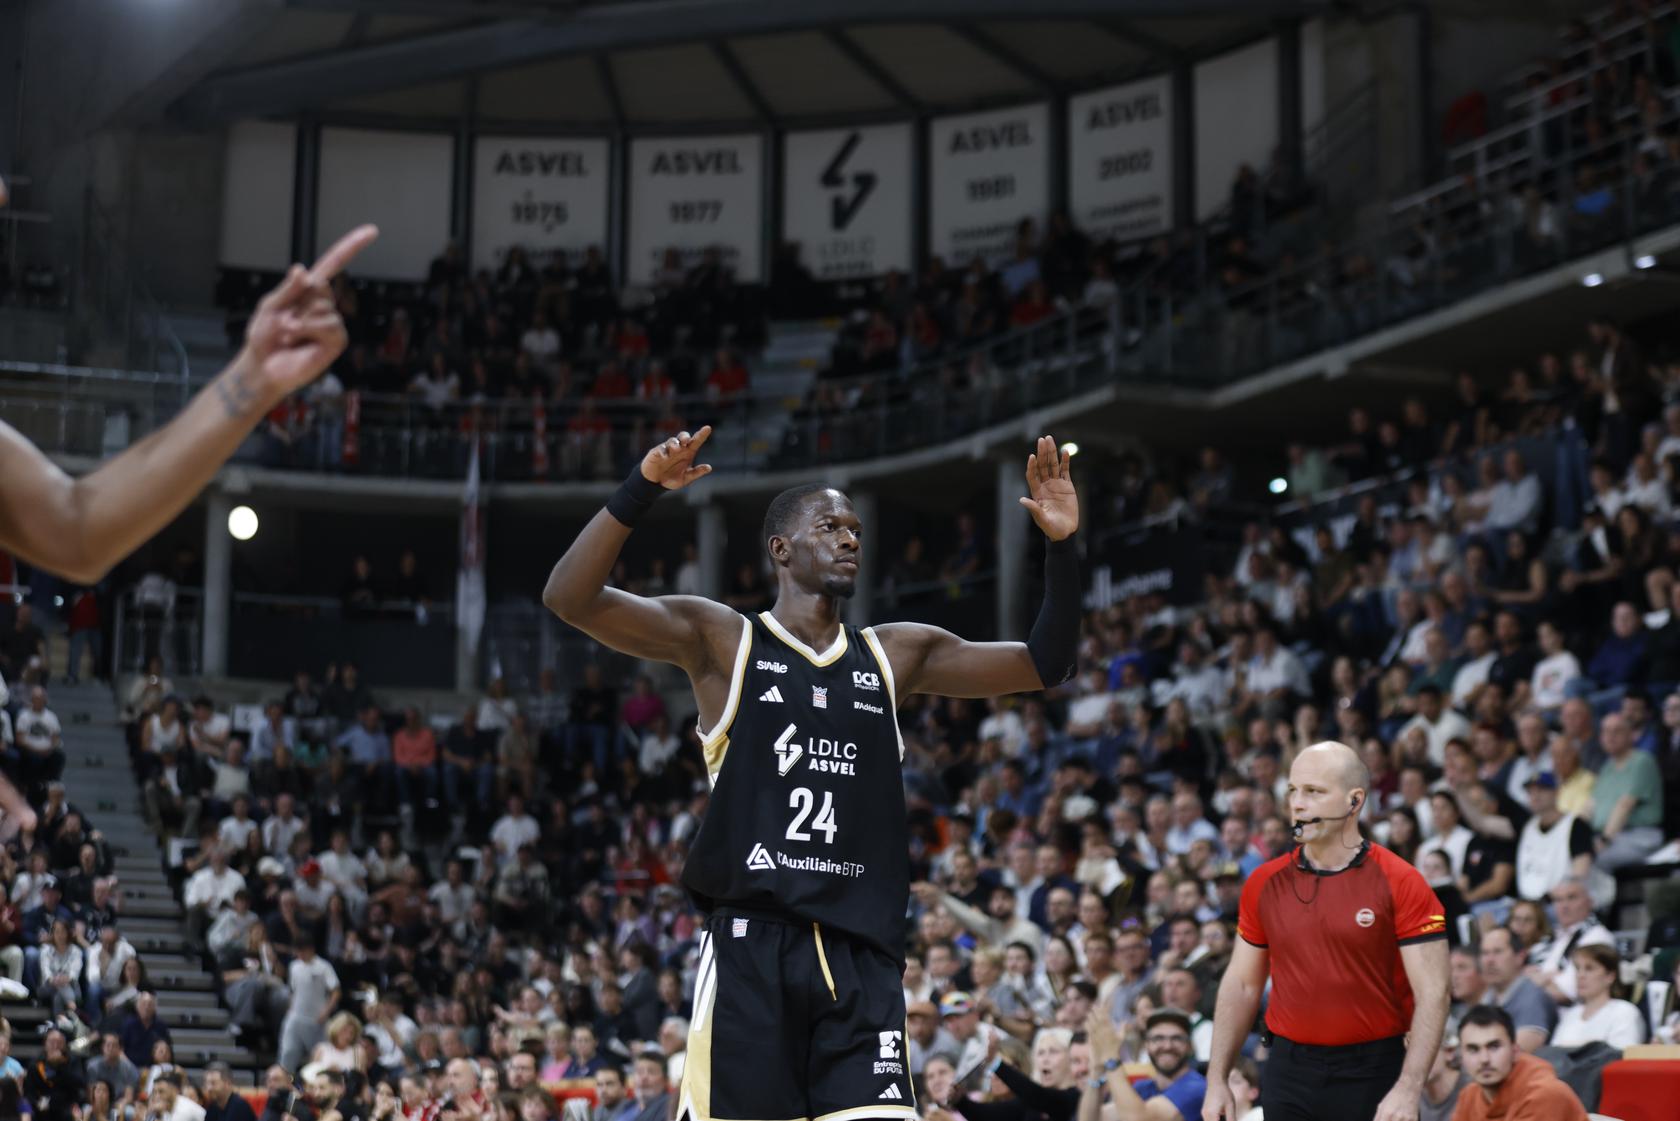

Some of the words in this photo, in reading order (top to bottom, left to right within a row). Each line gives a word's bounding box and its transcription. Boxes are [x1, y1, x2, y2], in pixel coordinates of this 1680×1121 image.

[1087, 94, 1164, 131] ASVEL
[949, 119, 1034, 155] ASVEL
[495, 149, 589, 177] ASVEL
[650, 148, 742, 177] ASVEL
[1098, 148, 1154, 181] 2002
[668, 200, 724, 225] 1977
[852, 671, 880, 687] DCB
[808, 737, 858, 760] LDLC
[808, 758, 856, 776] ASVEL
[785, 786, 838, 844] 24
